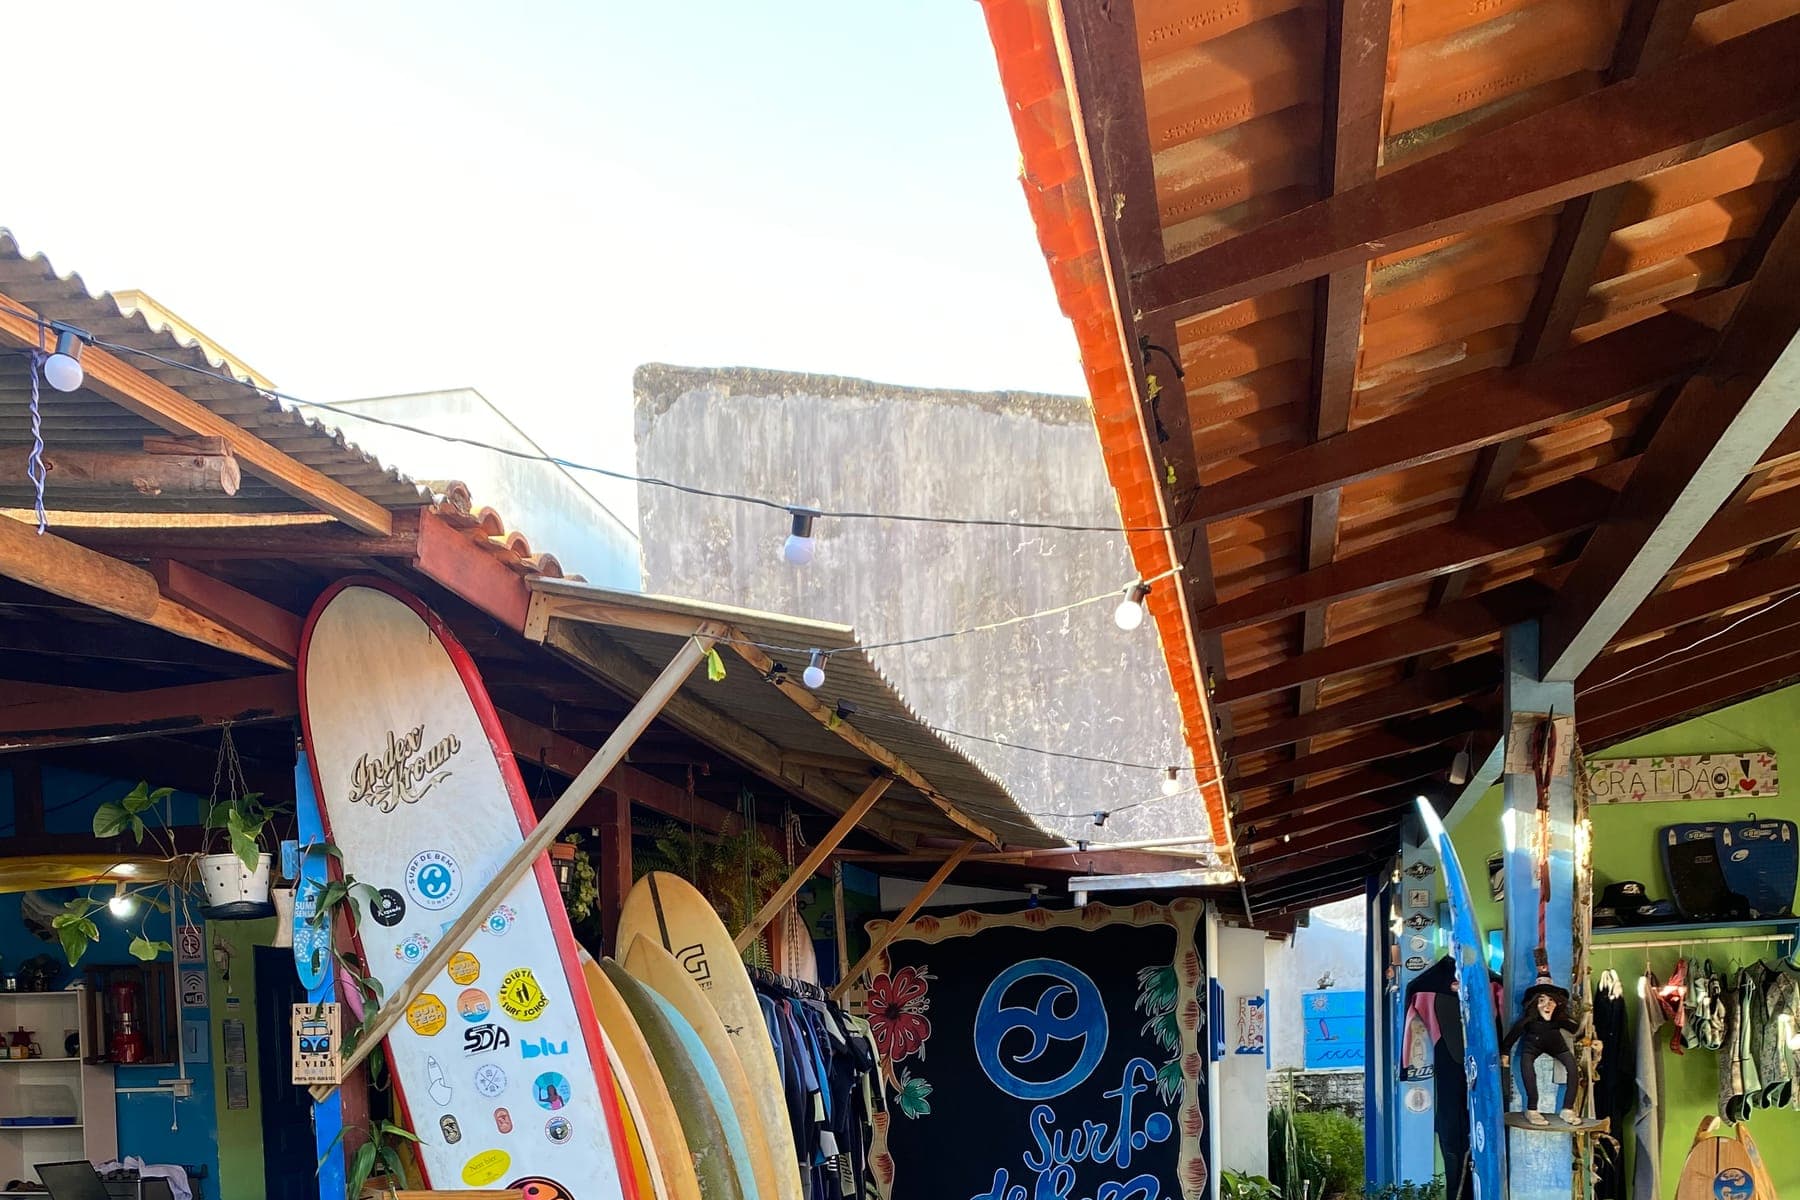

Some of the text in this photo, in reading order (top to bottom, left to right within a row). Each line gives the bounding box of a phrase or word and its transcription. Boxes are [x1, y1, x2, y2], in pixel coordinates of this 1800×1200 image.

[349, 724, 424, 803] Index
[408, 852, 454, 885] SURF DE BEM
[500, 970, 535, 995] EVOLUTI
[502, 1001, 522, 1016] SURF
[463, 1023, 511, 1053] SDA
[520, 1036, 569, 1059] blu
[305, 1060, 335, 1068] VIDA
[1023, 1057, 1157, 1170] Surf
